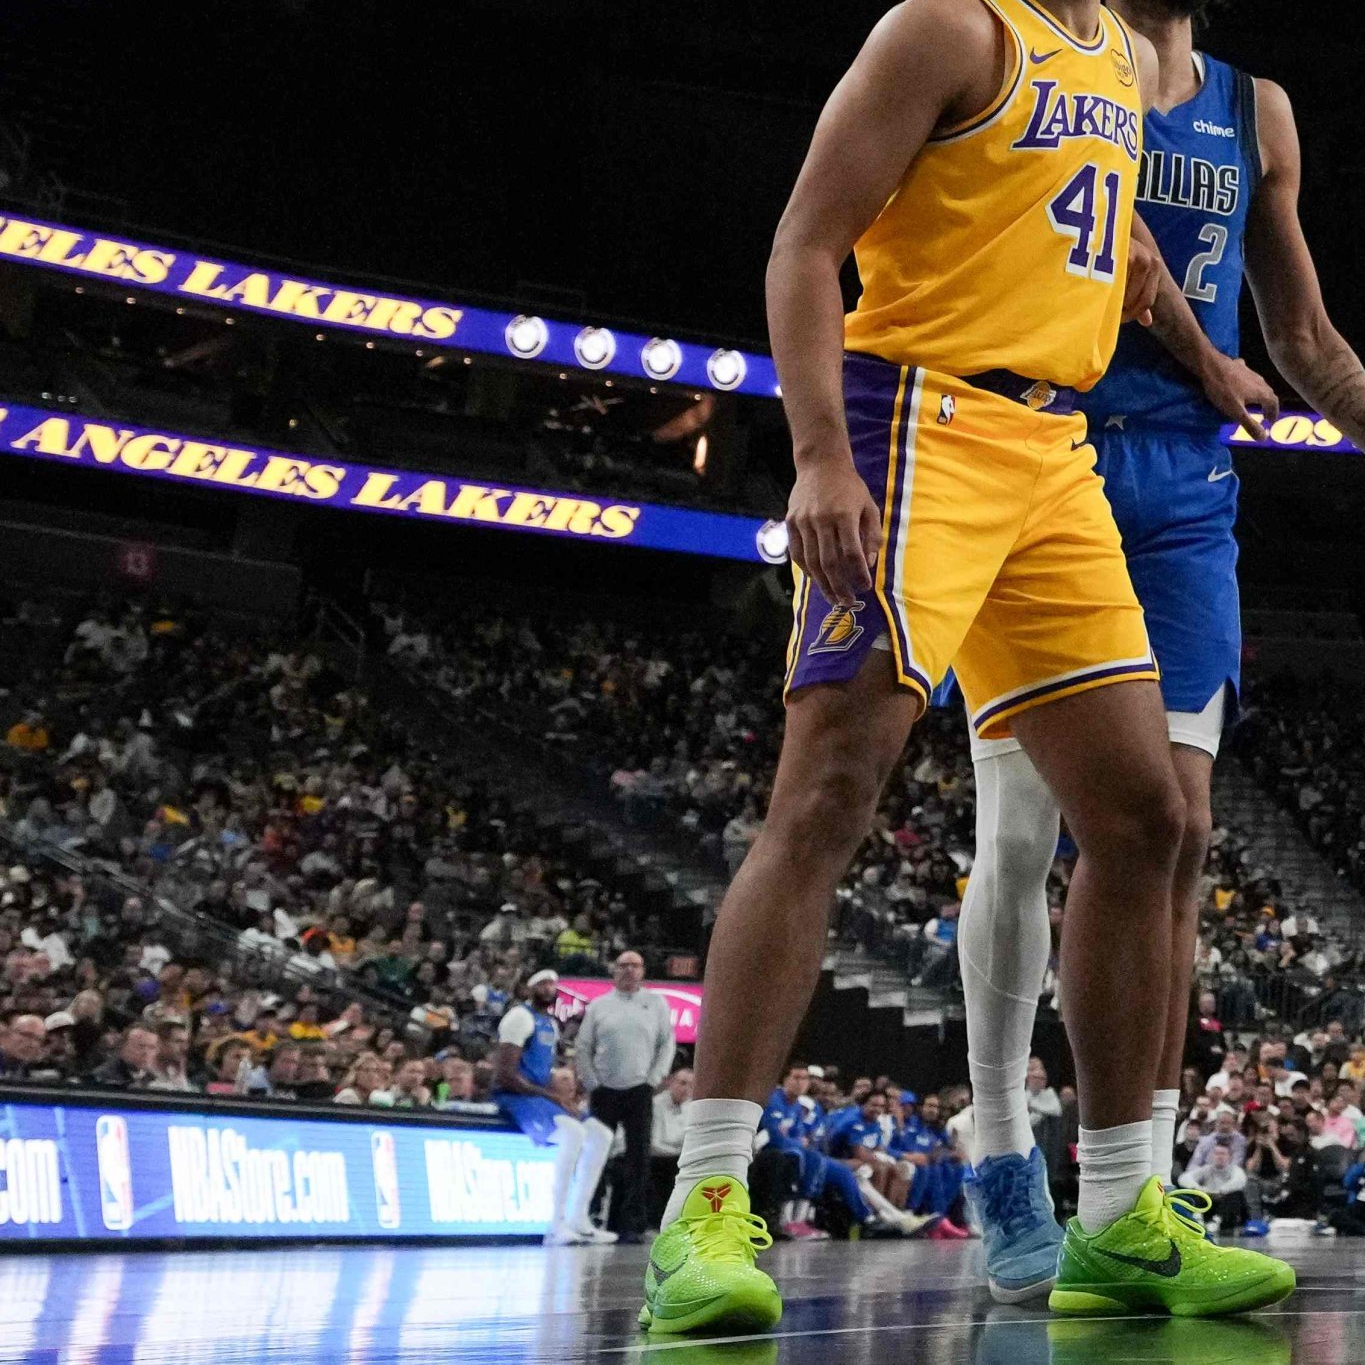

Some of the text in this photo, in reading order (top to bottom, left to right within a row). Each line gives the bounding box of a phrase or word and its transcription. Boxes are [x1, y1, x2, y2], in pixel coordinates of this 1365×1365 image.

[1010, 79, 1138, 162] LAKERS
[1193, 120, 1235, 138] chime
[1045, 163, 1121, 283] 41
[1135, 149, 1239, 216] LLAS
[0, 217, 463, 340] ELES LAKERS
[1183, 223, 1228, 303] 2
[12, 418, 641, 539] ANGELES LAKERS
[168, 1125, 351, 1224] NBAStore.com
